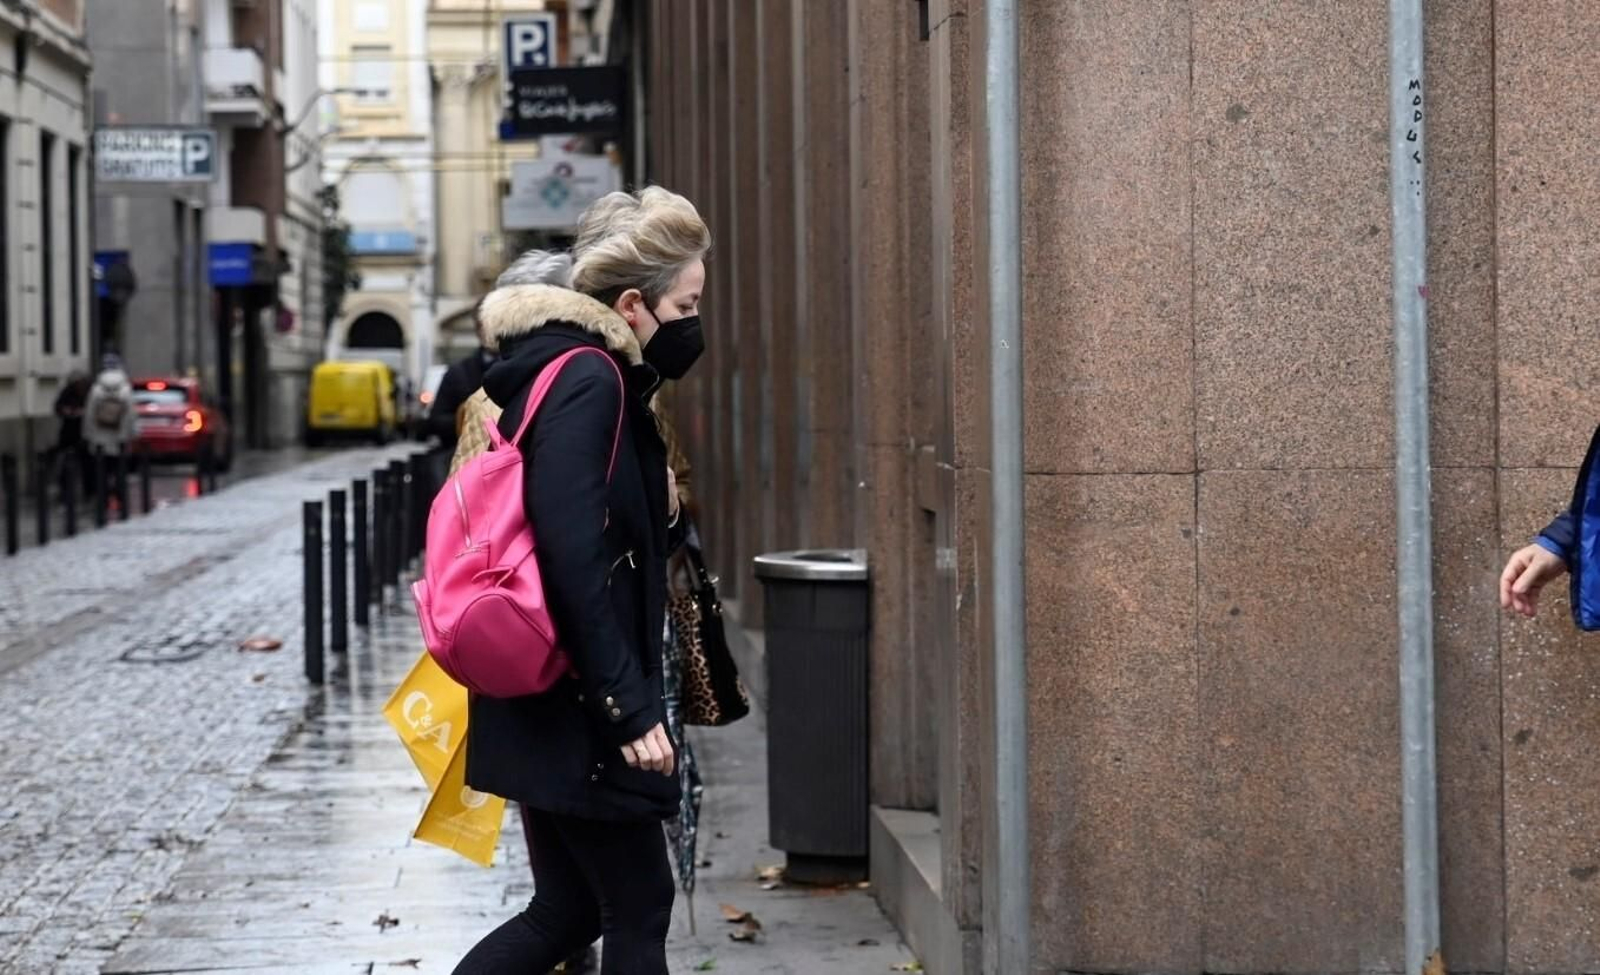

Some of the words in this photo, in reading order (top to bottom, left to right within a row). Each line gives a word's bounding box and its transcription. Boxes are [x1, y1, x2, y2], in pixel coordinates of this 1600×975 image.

[510, 24, 545, 66] P
[185, 138, 209, 173] P
[402, 690, 453, 754] C&A
